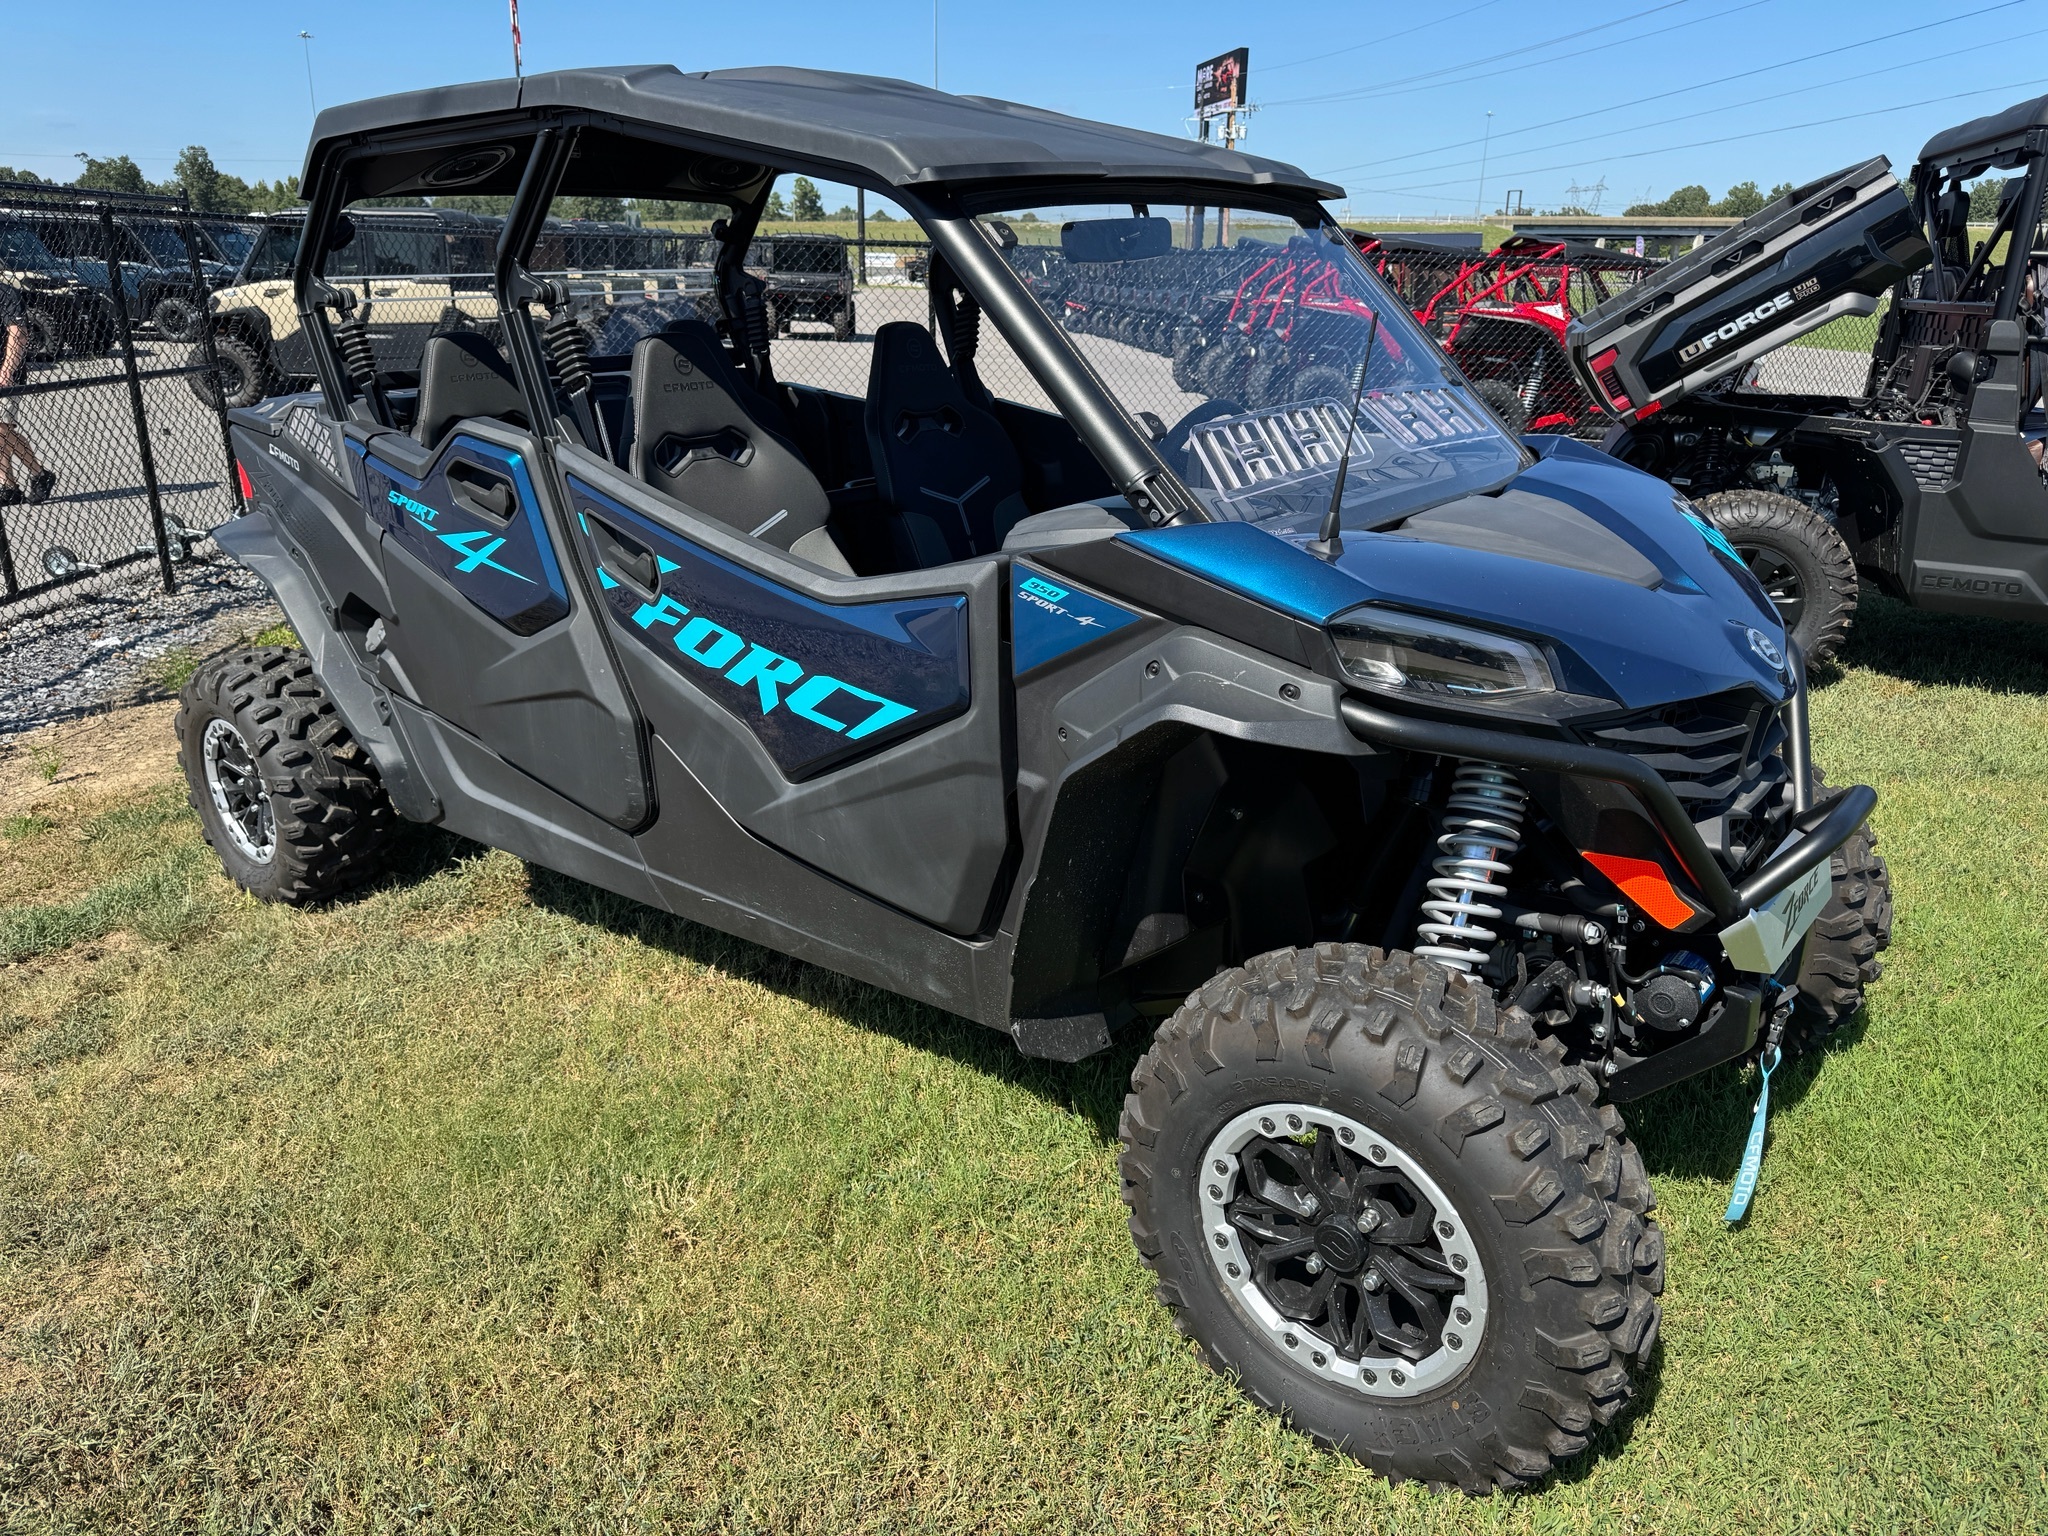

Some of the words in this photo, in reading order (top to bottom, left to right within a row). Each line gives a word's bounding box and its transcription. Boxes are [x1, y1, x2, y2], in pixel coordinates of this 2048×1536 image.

[1793, 277, 1817, 294] U10
[1796, 283, 1820, 300] PRO
[663, 381, 715, 393] CFMOTO
[268, 442, 300, 472] CFMOTO
[387, 490, 440, 521] SPORT
[1027, 581, 1061, 598] 950
[1921, 575, 2024, 596] CFMOTO
[1781, 865, 1821, 950] ZFORCE
[1733, 1131, 1763, 1205] CFMOTO
